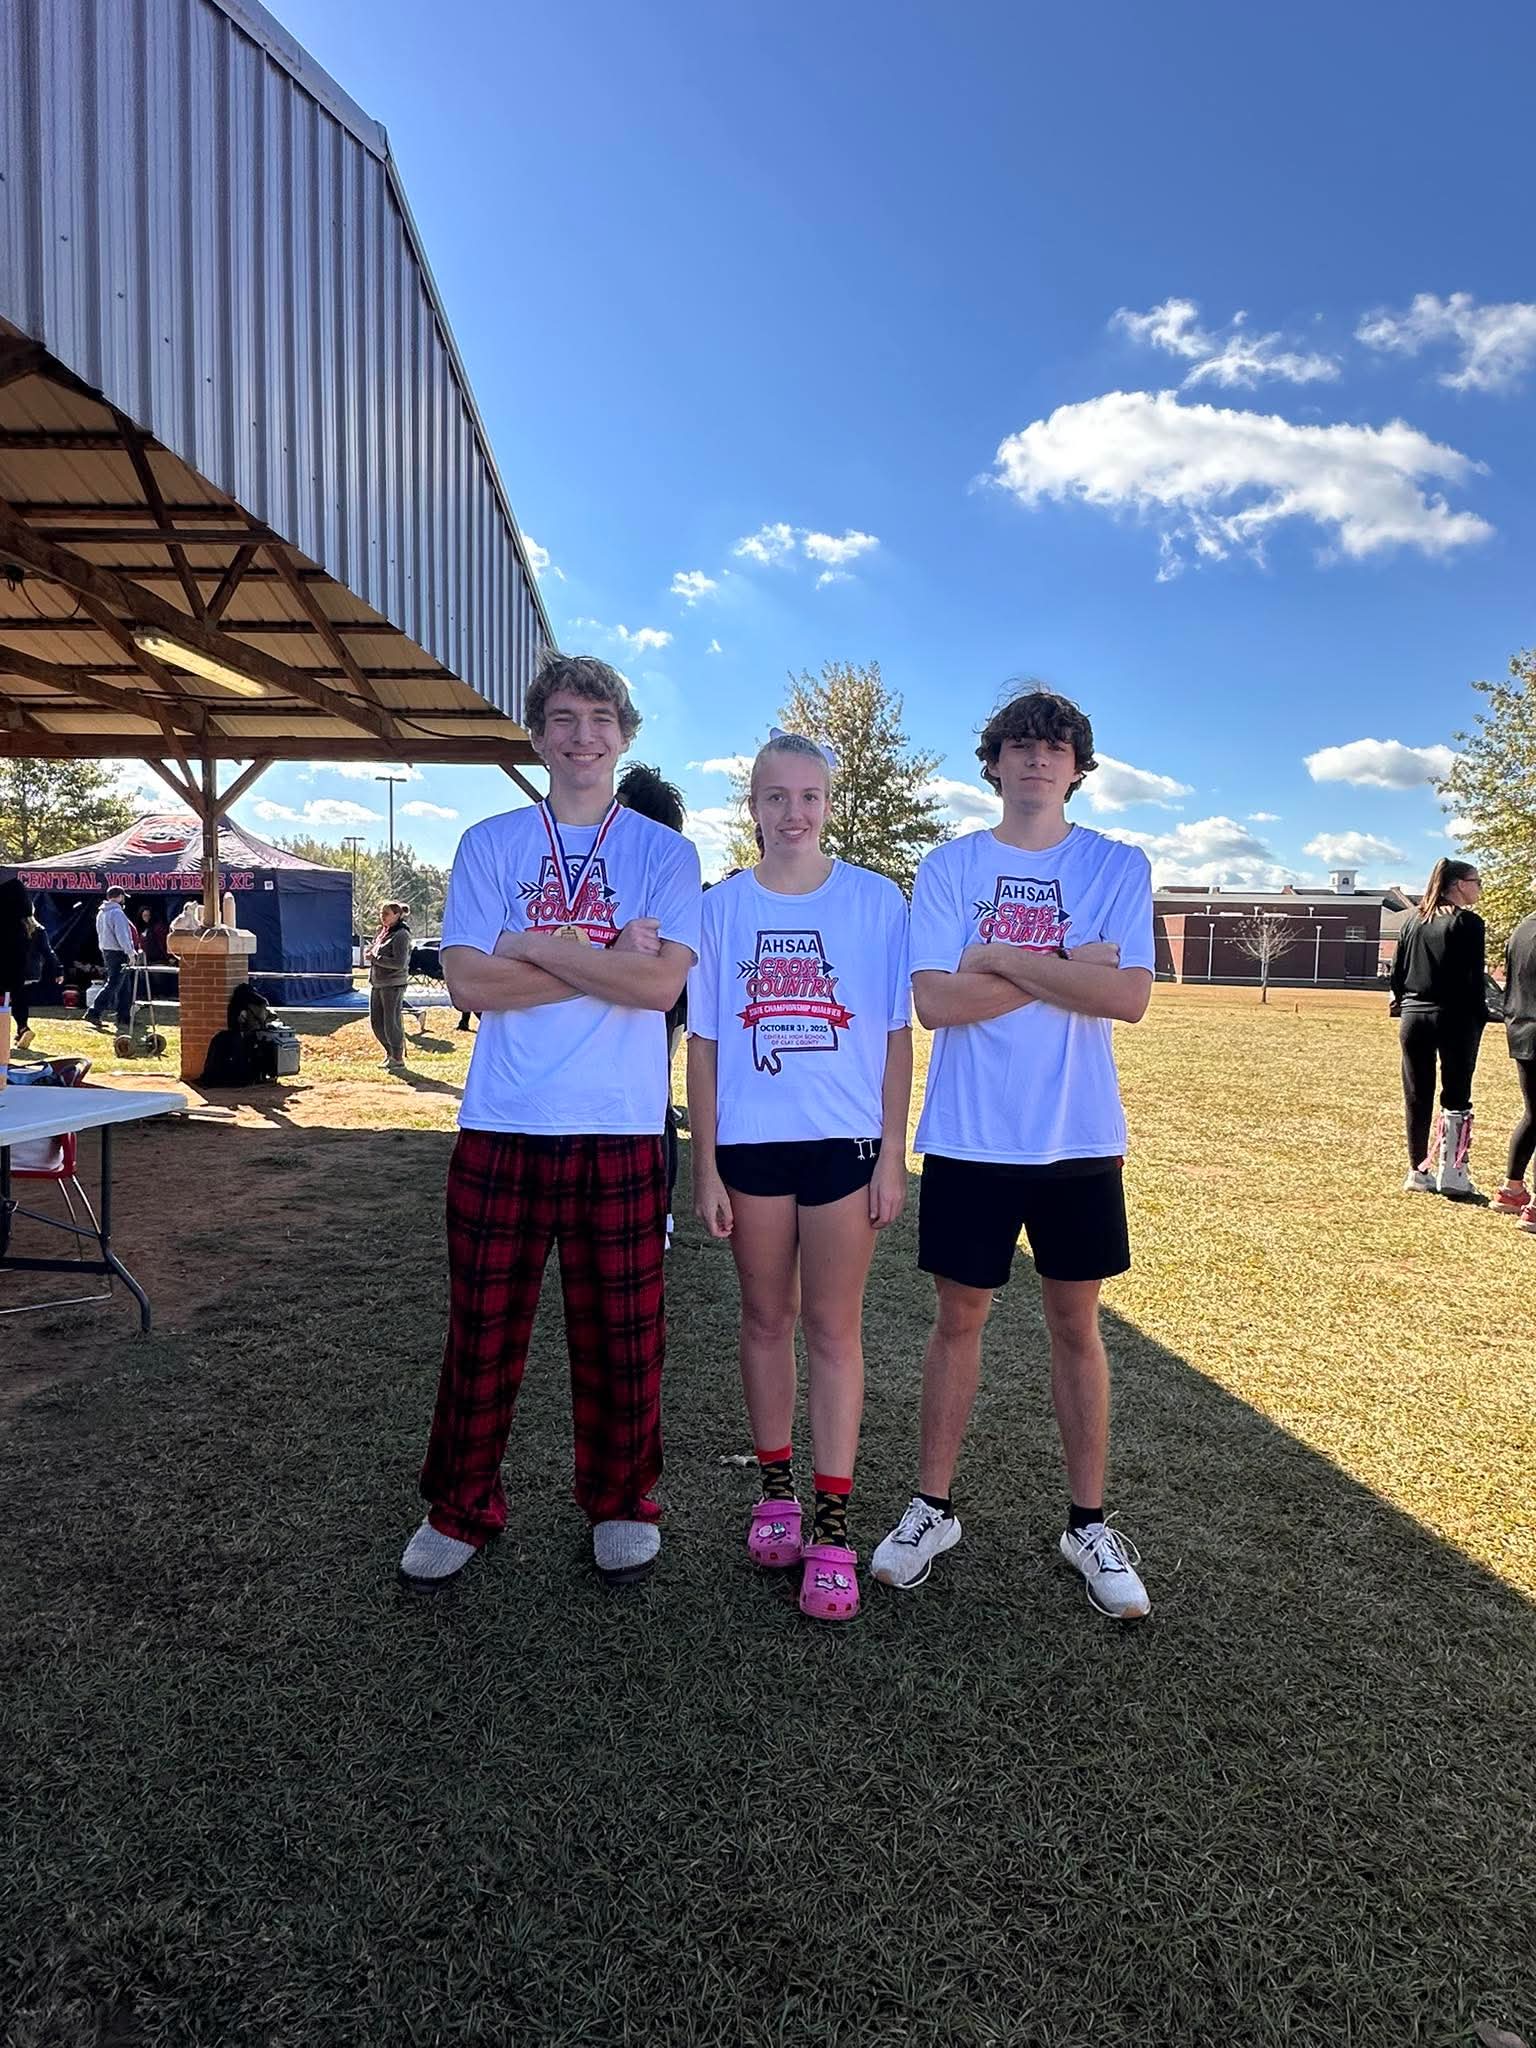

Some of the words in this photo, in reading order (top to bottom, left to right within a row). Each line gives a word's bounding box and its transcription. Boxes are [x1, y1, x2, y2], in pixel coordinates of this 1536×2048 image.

[545, 863, 601, 879] ASA
[17, 871, 102, 890] CENTRAL
[104, 871, 226, 891] VOLUNTEES
[230, 872, 254, 890] XC
[1001, 884, 1056, 903] AHSAA
[998, 902, 1057, 926] CROSS
[979, 917, 1072, 944] COUNTRY
[761, 939, 818, 953] AHSAA
[760, 957, 821, 978] CROSS
[746, 976, 839, 999] COUNTRY
[764, 1004, 811, 1013] CHAMPIONSHIP
[811, 1005, 841, 1017] QUALIFIER
[760, 1024, 795, 1032] OCTOBER
[797, 1024, 809, 1032] 31,
[810, 1024, 828, 1033] 2025
